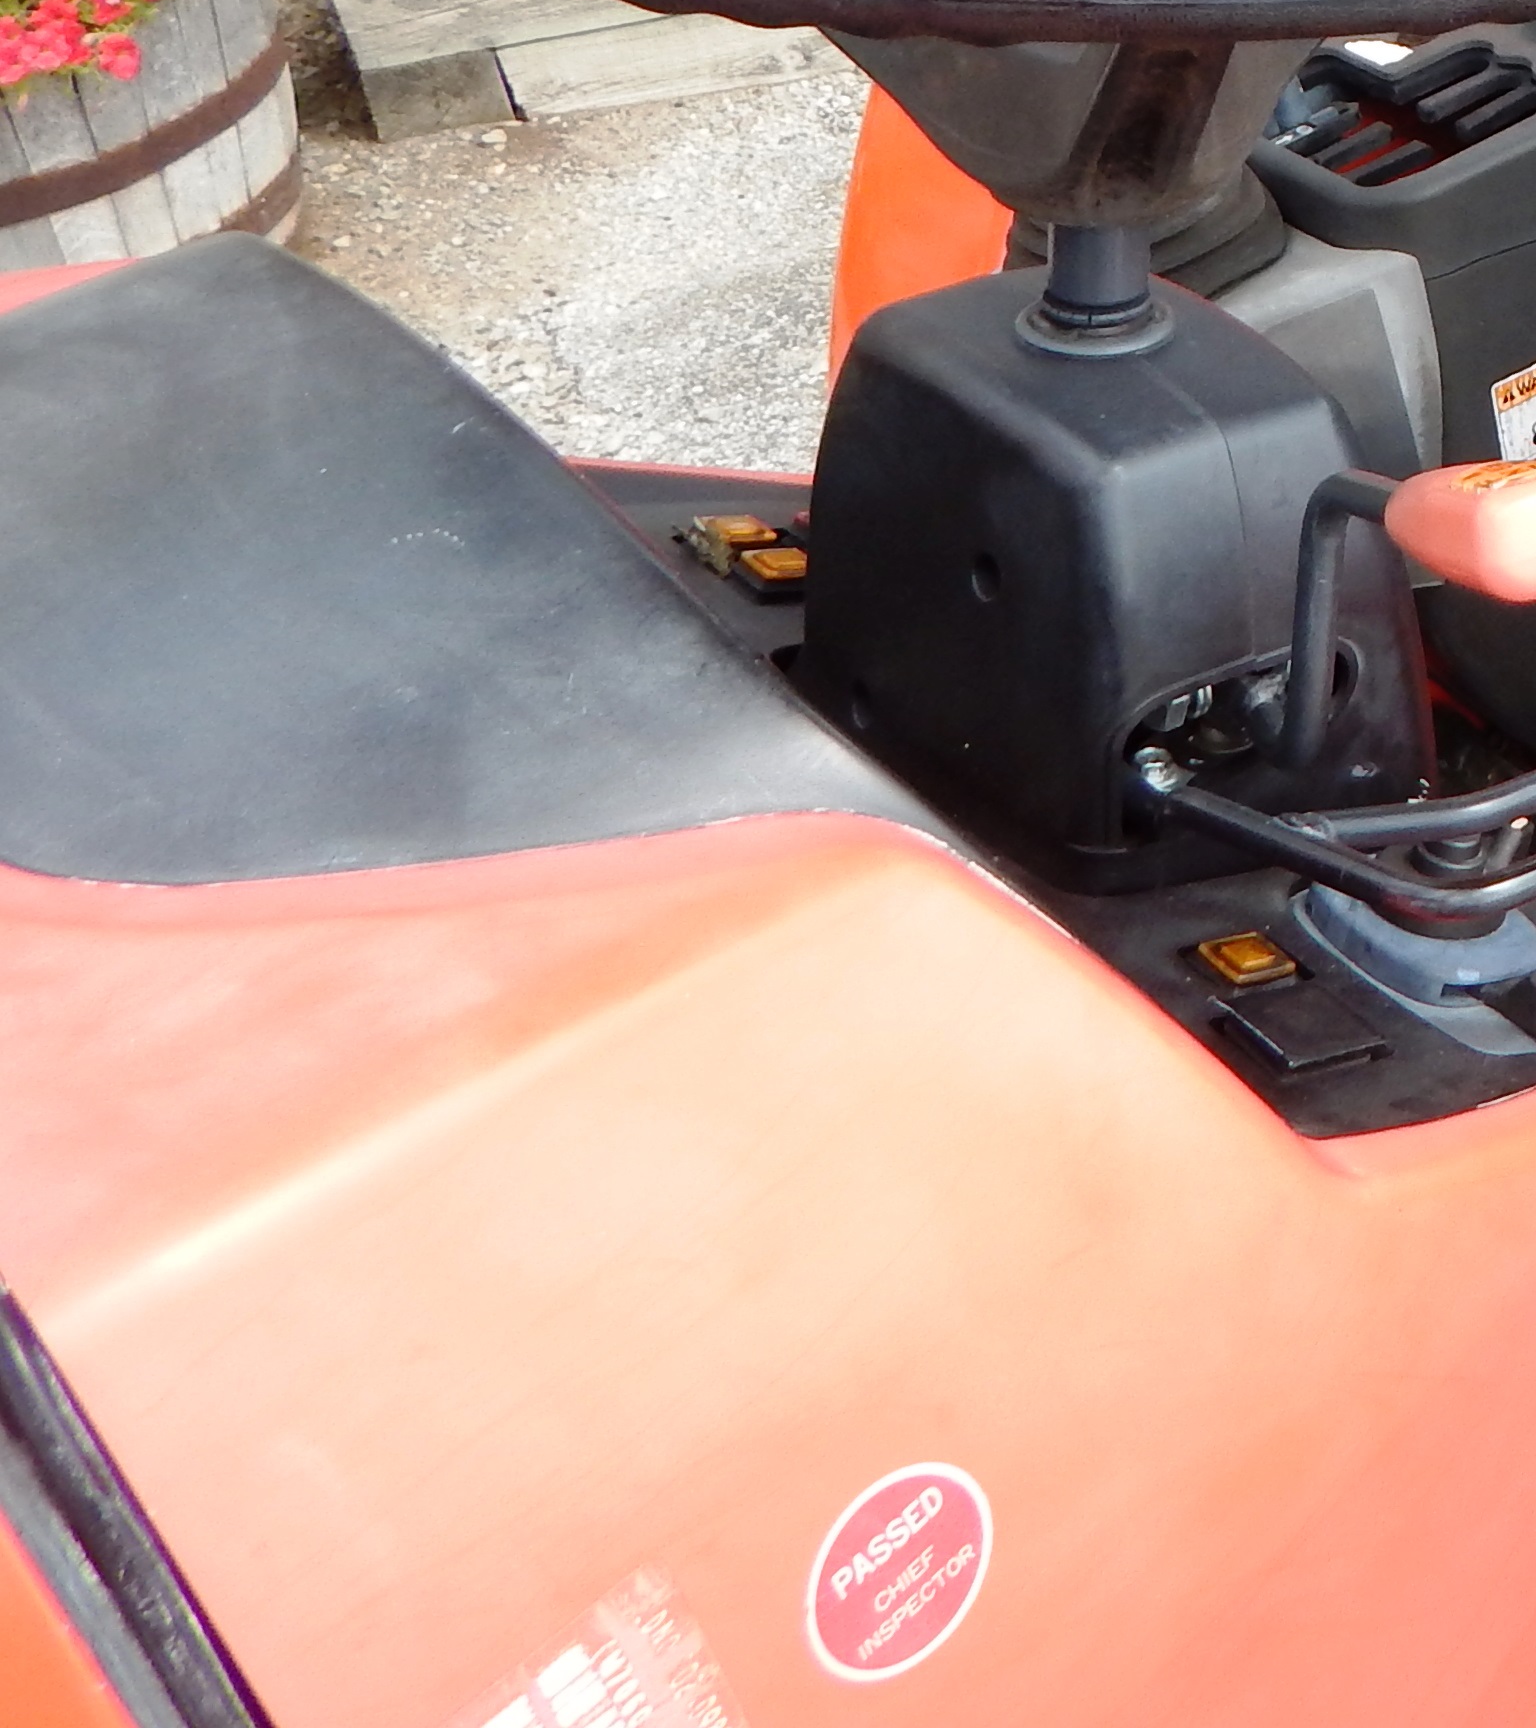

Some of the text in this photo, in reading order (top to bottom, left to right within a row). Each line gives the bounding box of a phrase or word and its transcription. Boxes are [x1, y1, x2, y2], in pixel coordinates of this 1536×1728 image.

[829, 1485, 945, 1601] PASSED
[874, 1543, 936, 1614] CHIEF
[856, 1542, 976, 1662] INSPECTOR
